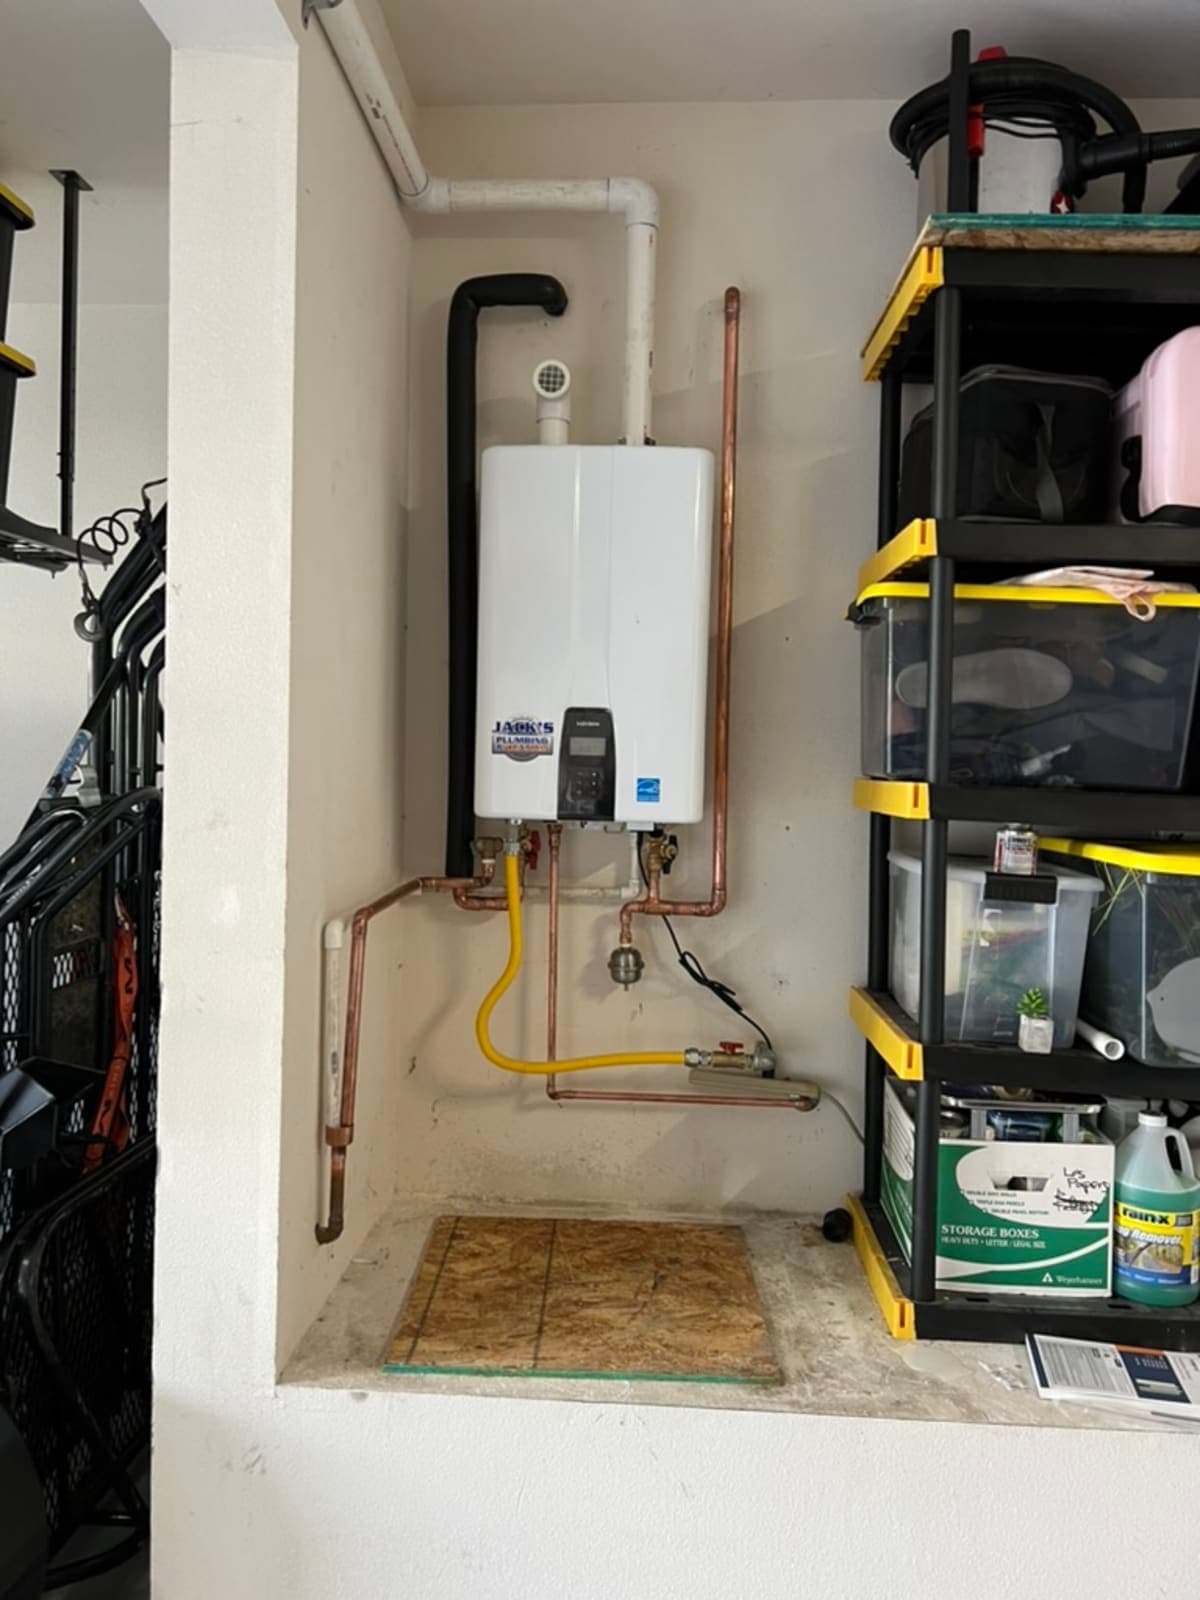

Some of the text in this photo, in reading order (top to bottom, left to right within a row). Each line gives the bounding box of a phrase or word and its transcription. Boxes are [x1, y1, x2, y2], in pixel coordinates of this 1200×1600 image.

[491, 721, 554, 734] JACK'S
[941, 1224, 1040, 1239] STORAGE BOXES
[941, 1236, 961, 1244] HEAVY
[962, 1237, 979, 1245] DUTY
[985, 1239, 1008, 1247] LETTER
[1013, 1240, 1032, 1248] LEGAL
